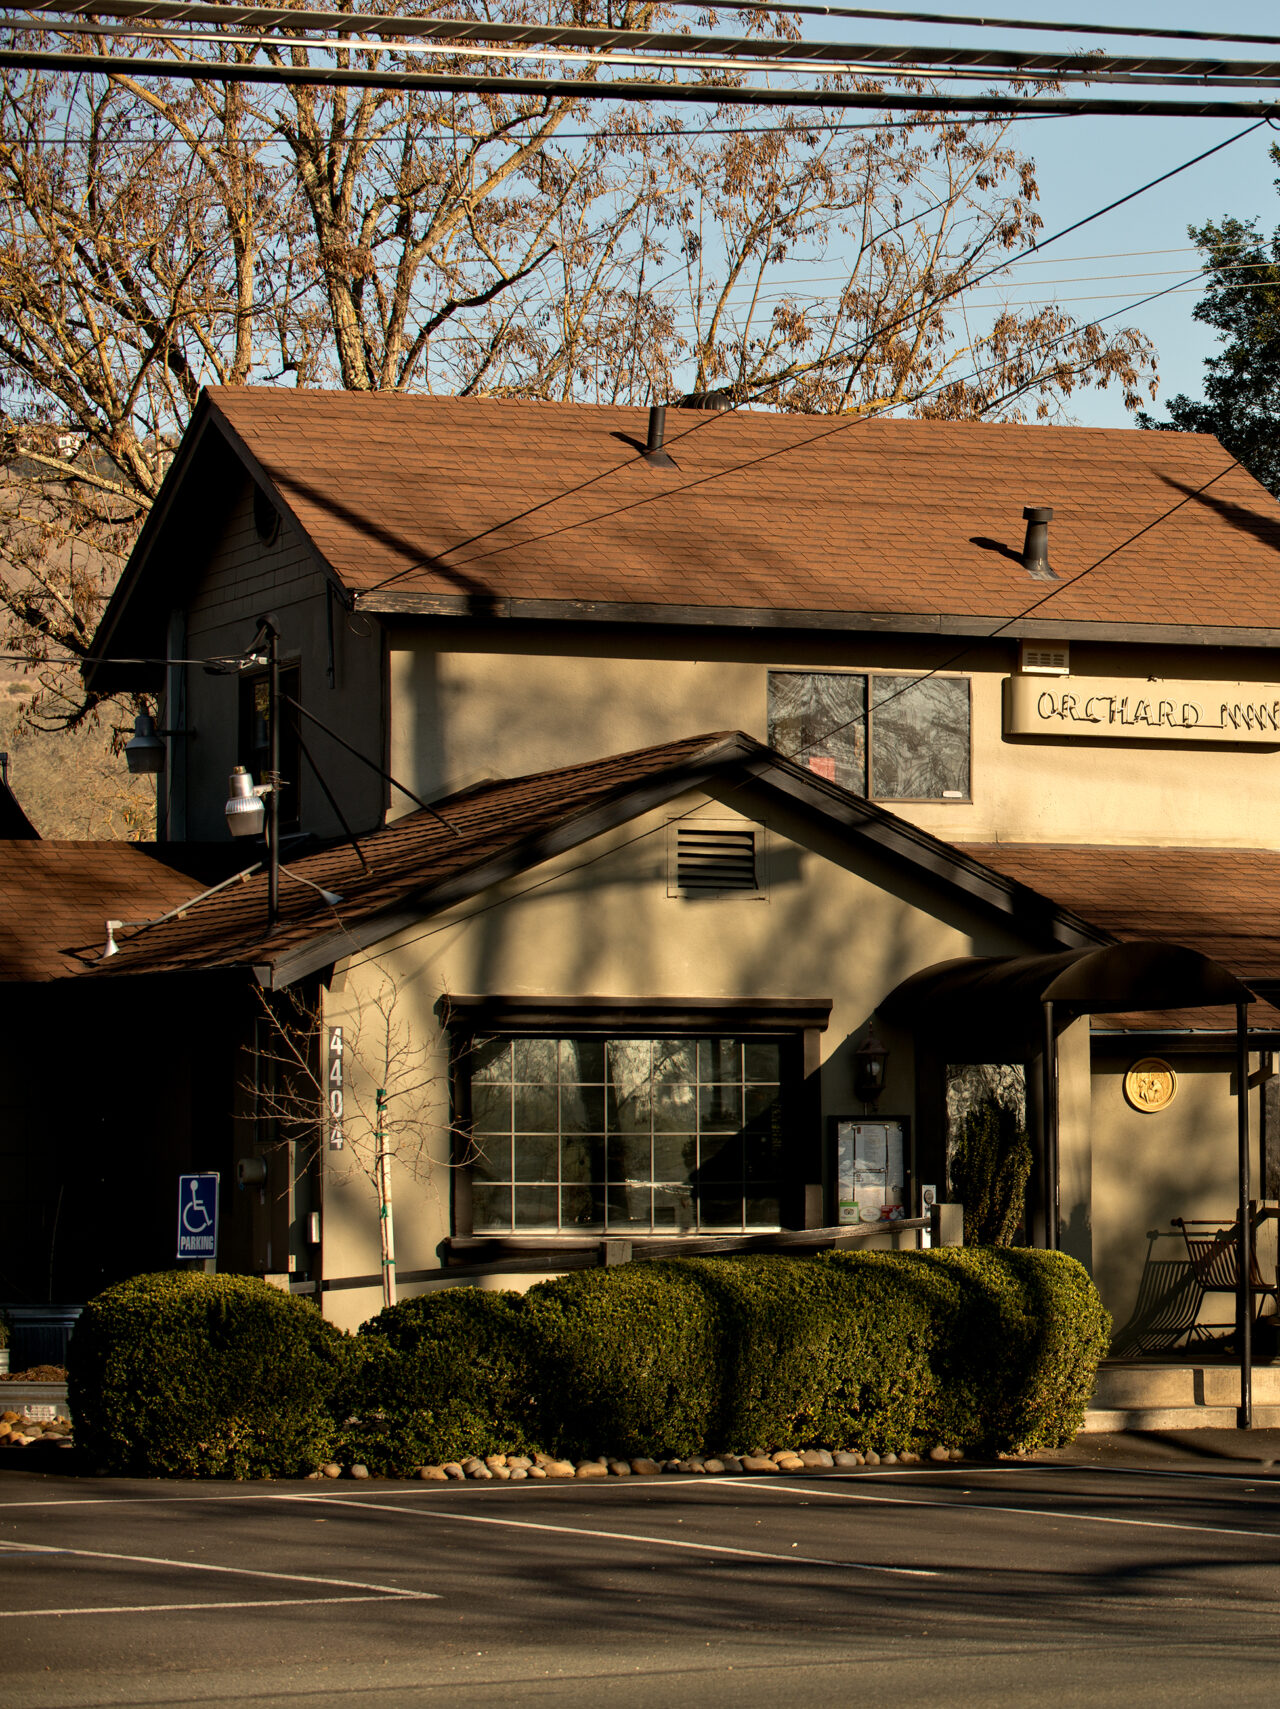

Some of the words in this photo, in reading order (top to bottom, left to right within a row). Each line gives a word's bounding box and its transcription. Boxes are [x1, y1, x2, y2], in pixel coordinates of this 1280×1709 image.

[1038, 690, 1204, 728] ORCHARD
[329, 1027, 344, 1150] 4404
[180, 1235, 214, 1251] PARKING
